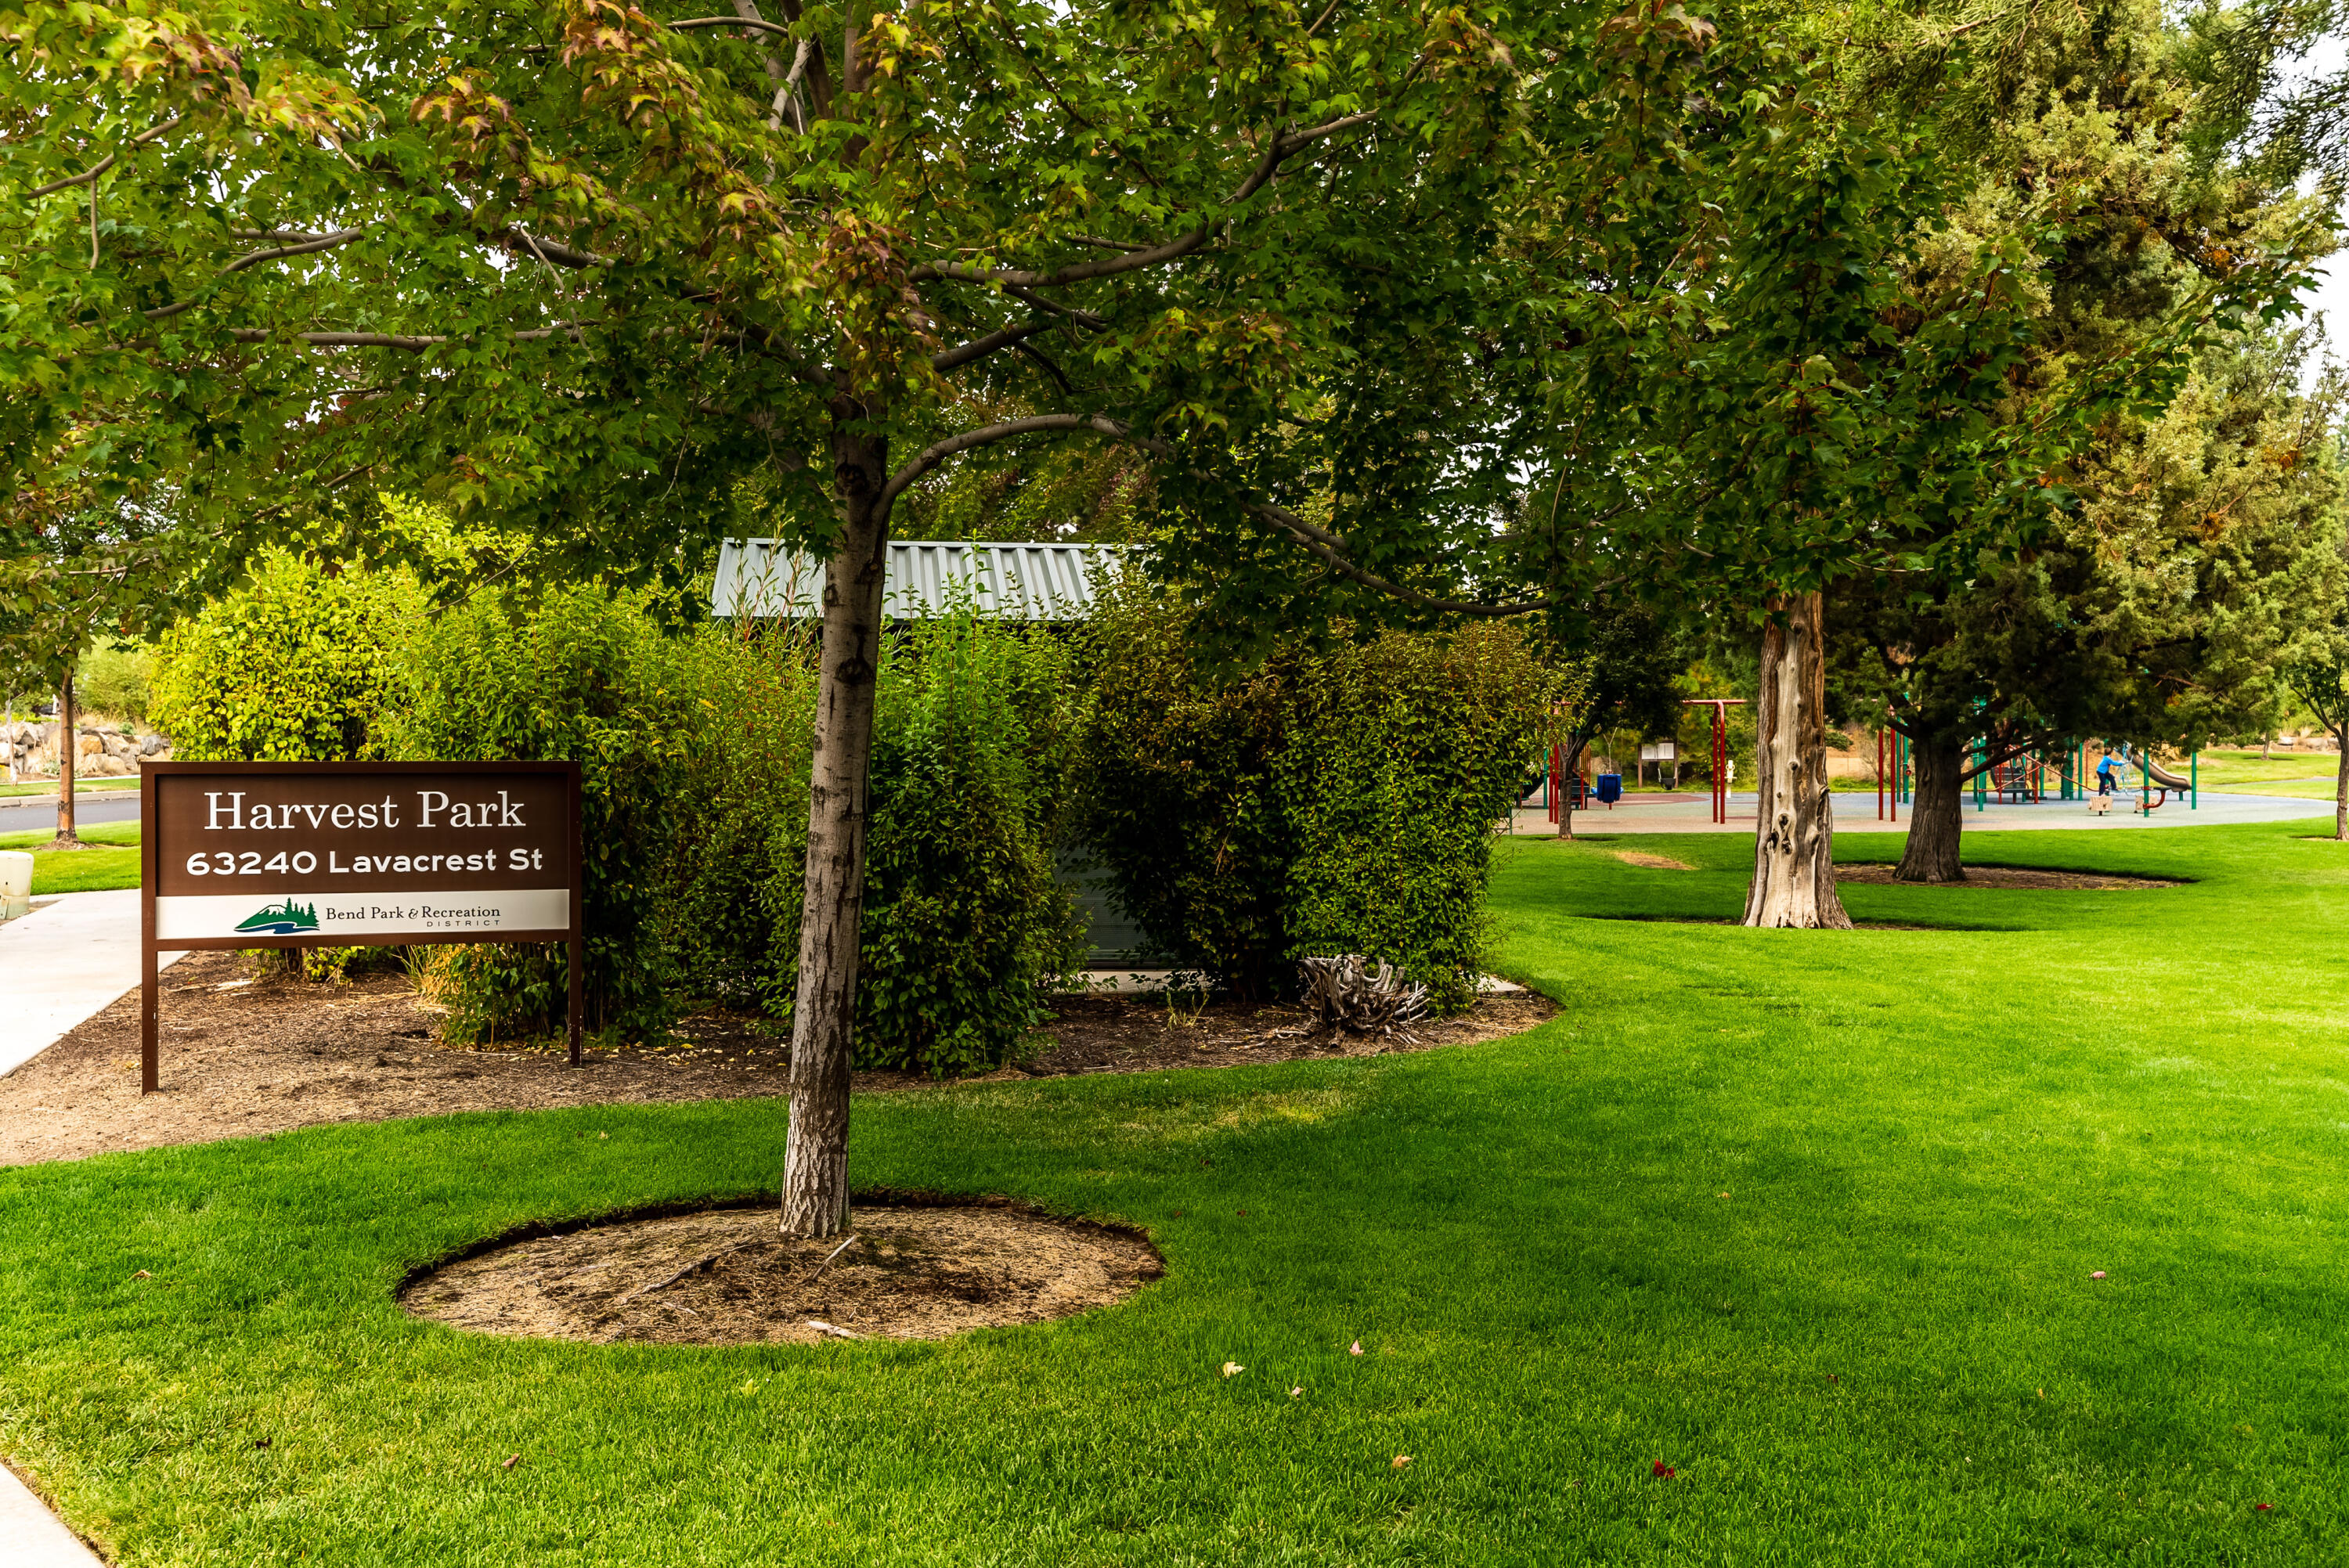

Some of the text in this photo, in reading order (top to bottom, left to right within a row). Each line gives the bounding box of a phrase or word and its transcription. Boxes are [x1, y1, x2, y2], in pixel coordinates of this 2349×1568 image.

[204, 791, 526, 830] Harvest Park
[186, 848, 543, 876] 63240 Lavacrest St
[326, 906, 501, 920] Bend Park & Recreation
[426, 919, 501, 928] DISTRICT
